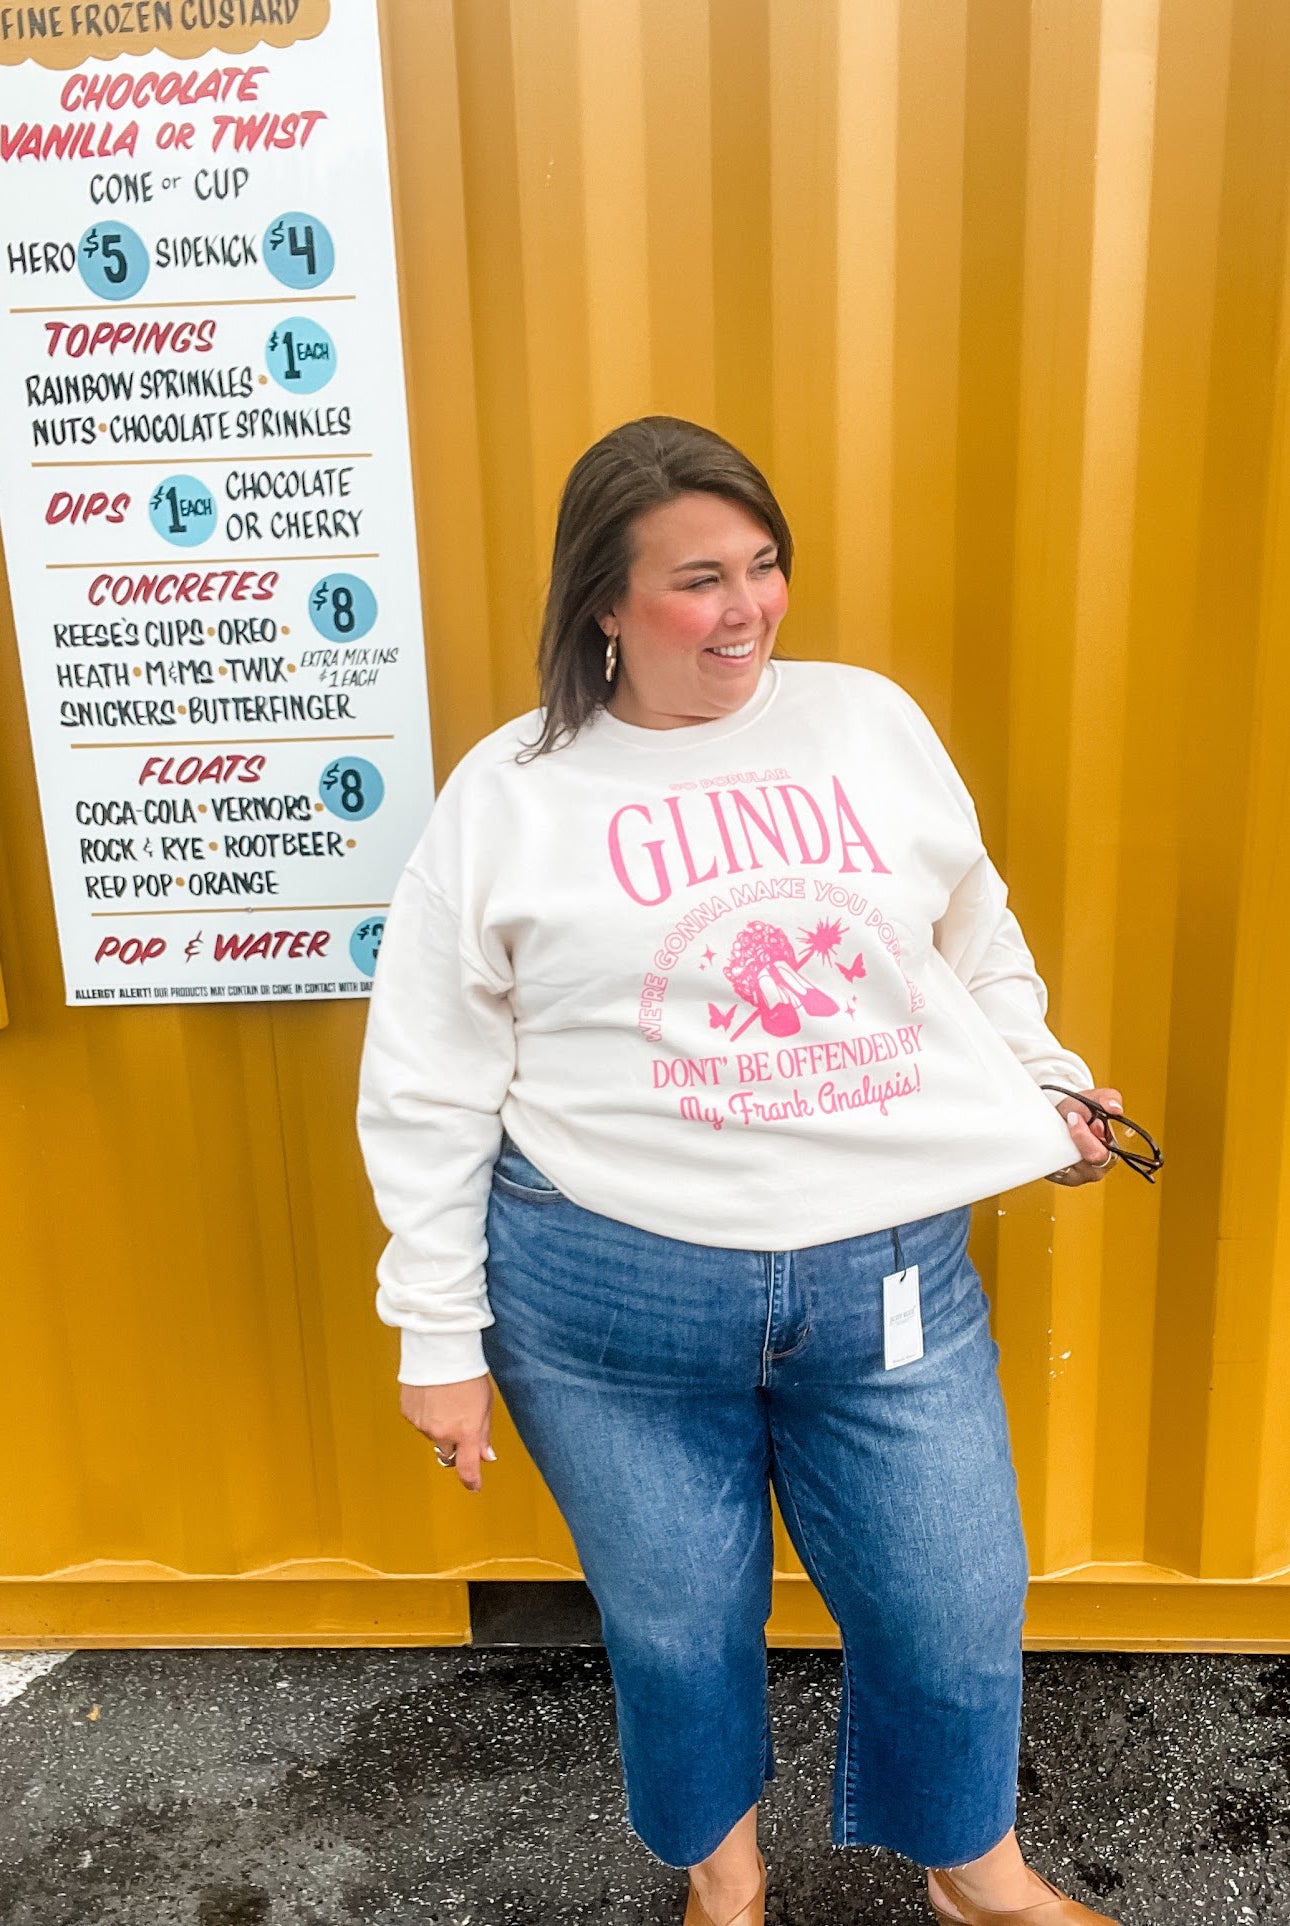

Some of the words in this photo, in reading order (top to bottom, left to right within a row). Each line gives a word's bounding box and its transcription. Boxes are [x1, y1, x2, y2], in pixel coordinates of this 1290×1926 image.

[1, 6, 63, 40] FINE
[71, 1, 173, 38] FROZEN
[181, 0, 300, 30] CUSTARD
[60, 66, 269, 111] CHOCOLATE
[0, 120, 138, 162] VANILLA
[156, 122, 195, 149] OR
[212, 111, 328, 152] TWIST
[90, 171, 153, 205] CONE
[194, 167, 249, 200] CUP
[7, 242, 75, 274] HERO
[83, 229, 128, 283] $5
[155, 234, 258, 268] SIDEKICK
[270, 221, 316, 275] $4
[45, 320, 217, 358] TOPPINGS
[268, 331, 300, 379] $1
[297, 342, 329, 360] EACH
[26, 371, 135, 407] RAINBOW
[140, 366, 253, 399] SPRINKLES
[32, 417, 96, 446] NUTS
[110, 412, 231, 443] CHOCOLATE
[236, 406, 351, 437] SPRINKLES
[226, 467, 354, 500] CHOCOLATE
[45, 492, 131, 525] DIPS
[152, 486, 186, 533] $1
[181, 498, 212, 517] EACH
[226, 512, 263, 541] OR
[270, 509, 364, 540] CHERRY
[88, 571, 279, 607] CONCRETES
[313, 582, 354, 633] $8
[54, 618, 138, 649] REESE'S
[145, 620, 204, 648] CUPS
[218, 617, 276, 644] OREO
[56, 662, 130, 688] HEATH
[224, 656, 288, 683] TWIX
[301, 648, 339, 667] EXTRA
[319, 669, 338, 687] $1
[341, 669, 379, 687] EACH
[59, 700, 176, 728] SNICKERS
[188, 693, 356, 725] BUTTERFINGER
[139, 755, 266, 786] FLOATS
[323, 764, 364, 813] $8
[700, 768, 791, 789] POPULAR
[75, 798, 198, 826] COCA-COLA
[210, 795, 311, 822] VERNORS
[80, 837, 138, 864] ROCK
[161, 836, 206, 861] RYE
[607, 775, 892, 907] GLINDA
[85, 875, 127, 899] RED
[133, 873, 173, 897] POP
[189, 870, 279, 895] ORANGE
[94, 936, 167, 966] POP
[184, 930, 203, 963] &
[213, 930, 330, 962] WATER
[638, 972, 668, 1042] WE'RE
[654, 896, 732, 971] GONNA
[729, 877, 806, 909] MAKE
[814, 879, 868, 915] YOU
[75, 988, 115, 999] ALLERGY
[119, 987, 151, 998] ALERT!
[154, 987, 168, 998] OUR
[171, 986, 208, 997] PRODUCTS
[210, 986, 225, 997] MAY
[228, 985, 259, 996] CONTAIN
[260, 984, 270, 995] OR
[272, 984, 293, 995] COME
[295, 983, 303, 994] IN
[305, 982, 336, 994] CONTACT
[339, 981, 358, 993] WITH
[737, 1052, 773, 1084] BE
[776, 1032, 899, 1078] OFFENDED
[898, 1024, 923, 1054] BY
[679, 1096, 724, 1130] My
[729, 1089, 814, 1125] Frank
[818, 1064, 922, 1116] Analysis!
